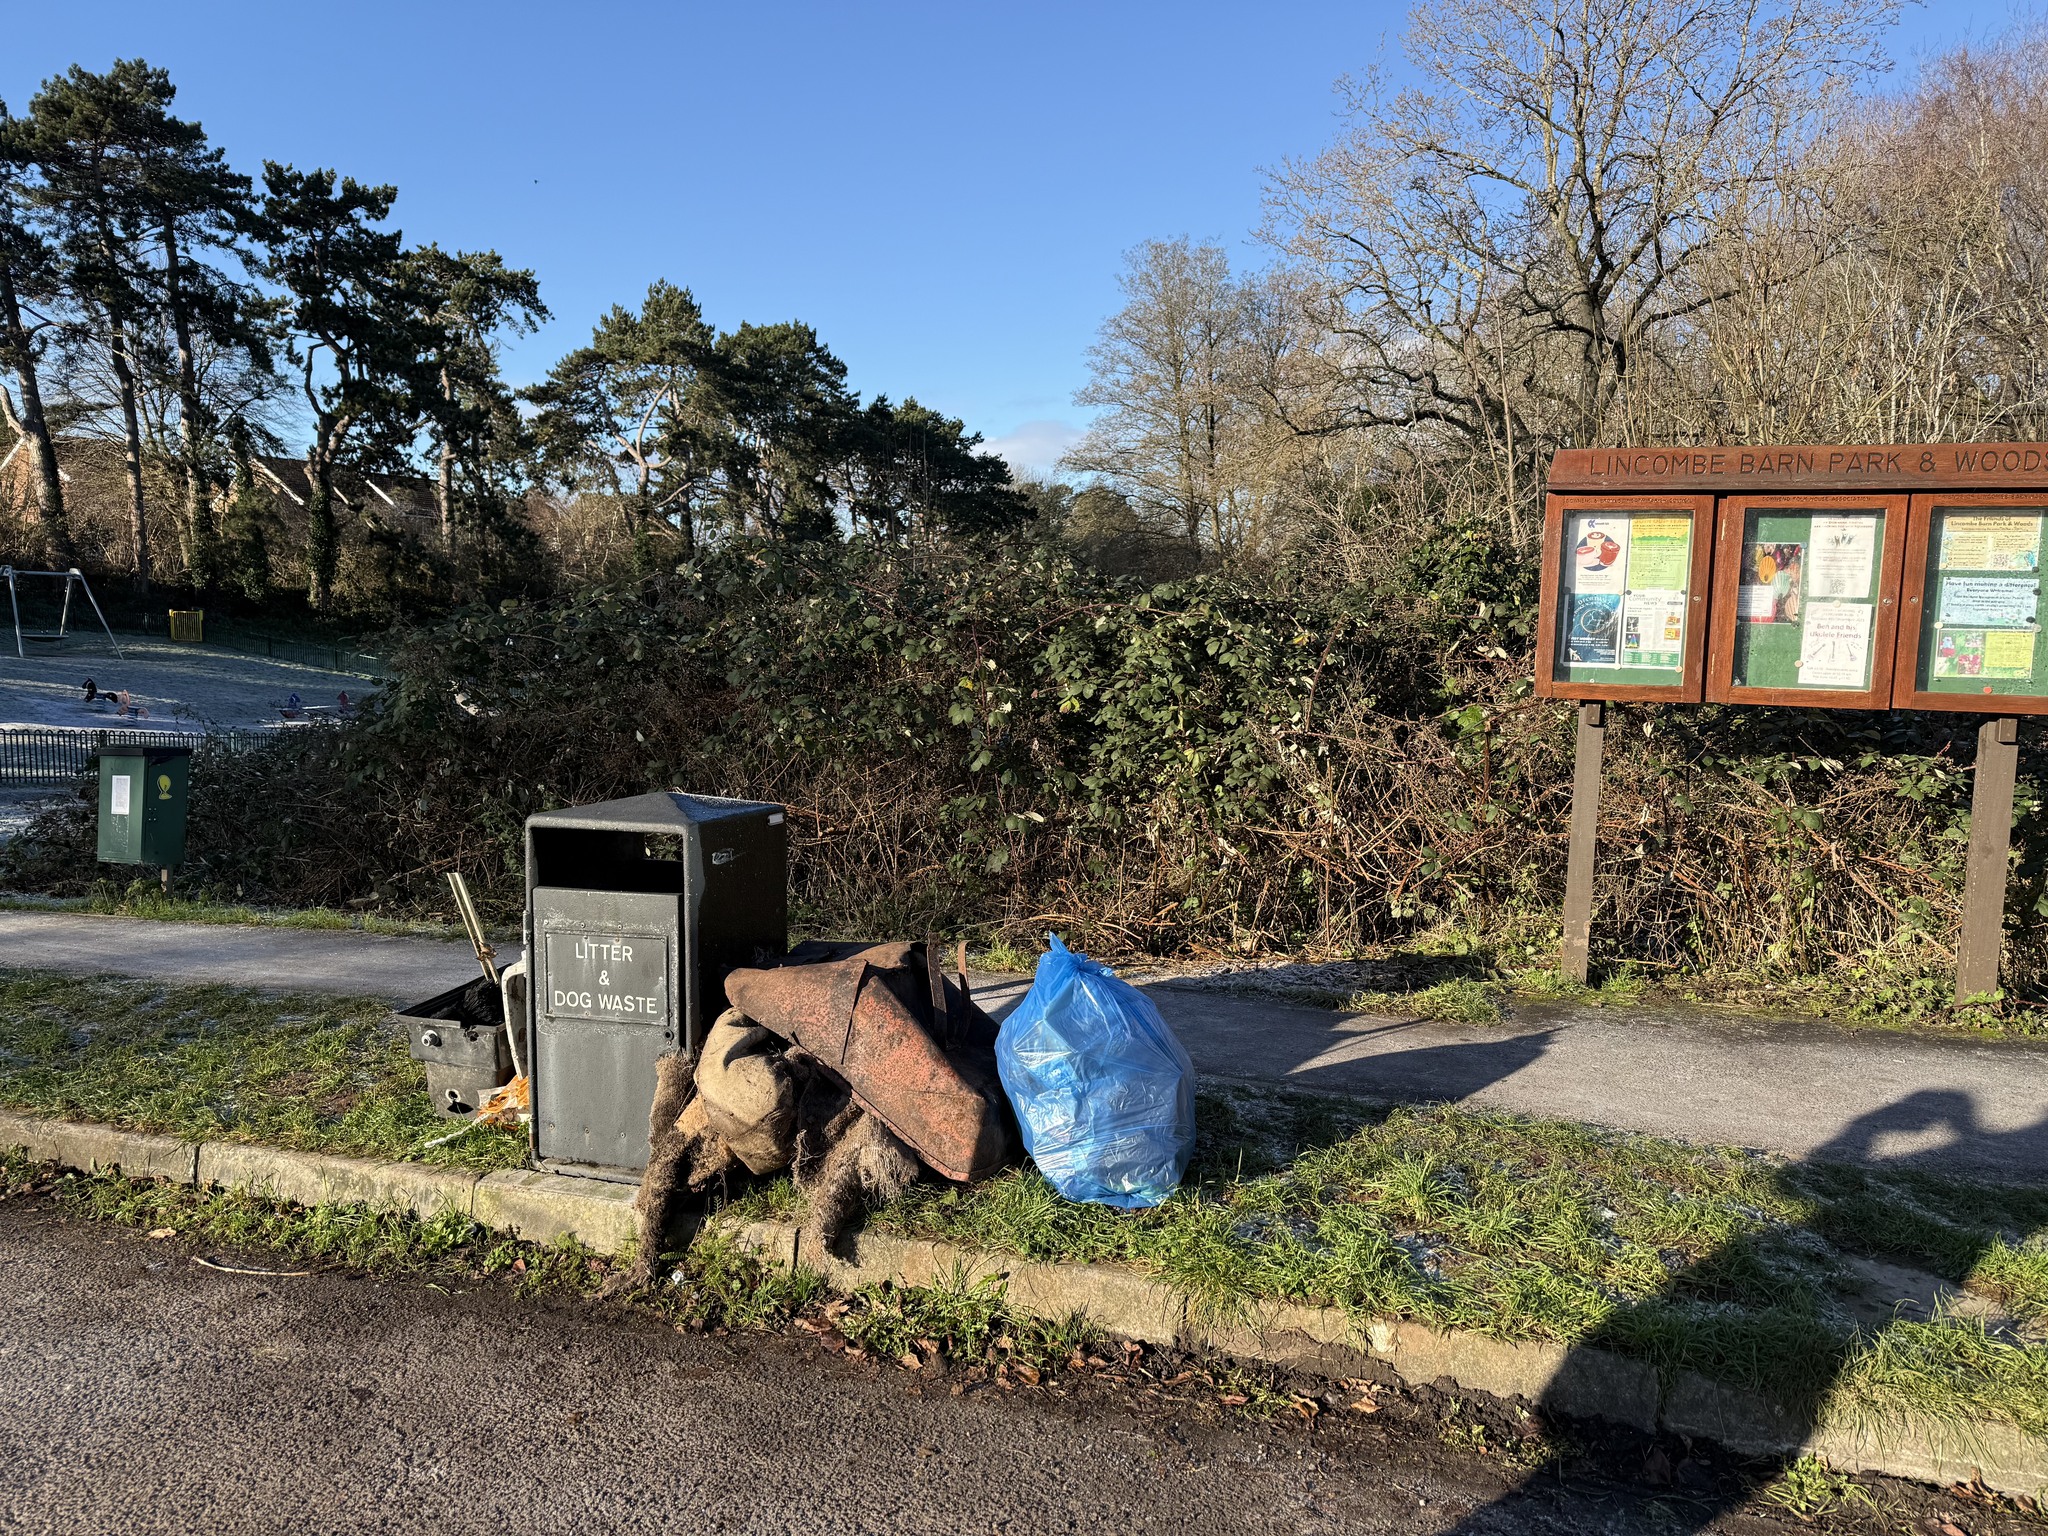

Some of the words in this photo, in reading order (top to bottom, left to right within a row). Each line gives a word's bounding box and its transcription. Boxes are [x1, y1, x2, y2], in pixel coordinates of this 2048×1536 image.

[1590, 454, 1725, 476] LINCOMBE
[1740, 453, 1814, 475] BARN
[1829, 452, 1901, 473] PARK
[1919, 451, 1937, 473] &
[1955, 450, 2048, 472] WOOD
[1836, 631, 1862, 639] Friends
[575, 942, 633, 962] LITTER
[598, 969, 610, 986] &
[554, 990, 592, 1009] DOG
[598, 993, 658, 1014] WASTE
